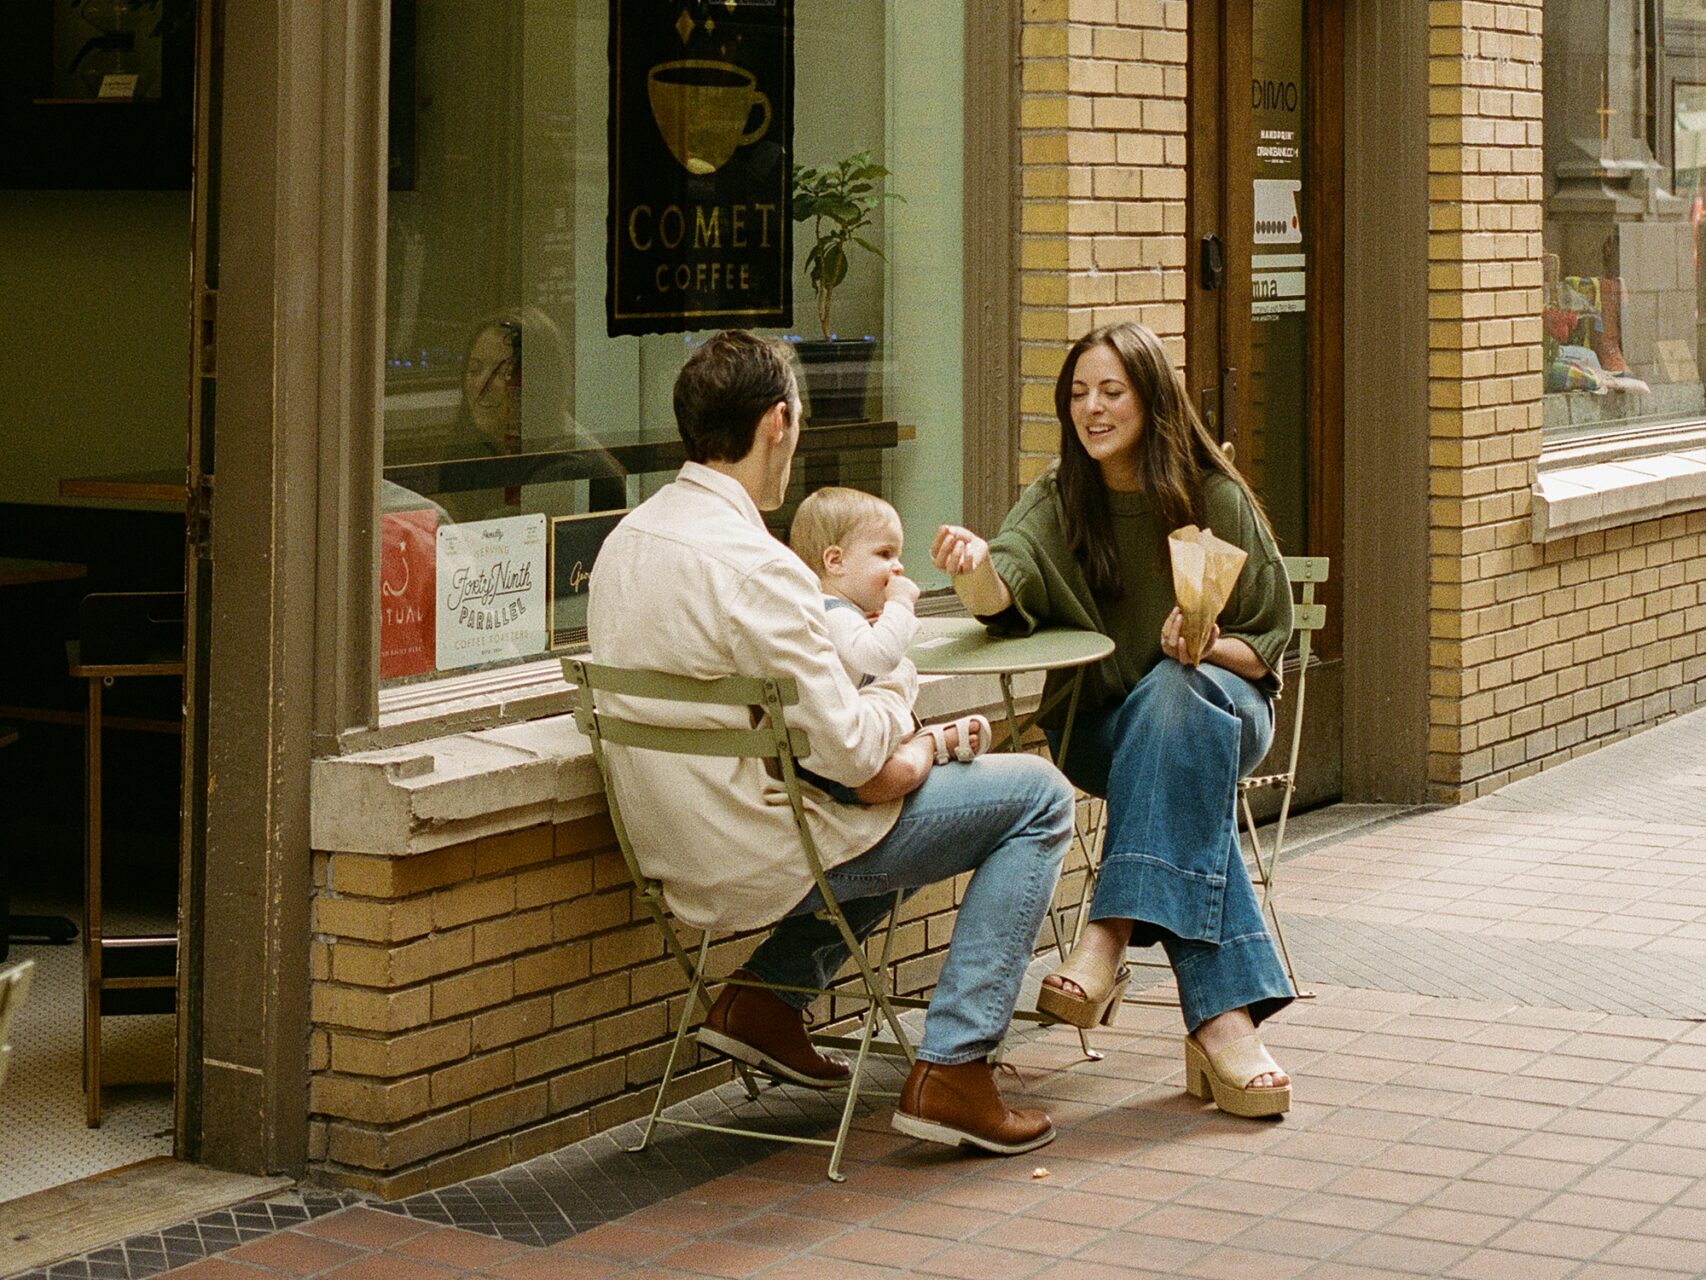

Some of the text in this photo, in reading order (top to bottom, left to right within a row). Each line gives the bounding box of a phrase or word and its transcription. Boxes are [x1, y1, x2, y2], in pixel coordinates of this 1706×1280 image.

[1251, 79, 1298, 112] DIMO
[628, 203, 775, 251] COMET
[656, 263, 751, 292] COFFEE
[447, 560, 532, 611] Forty Ninth
[380, 606, 424, 627] TUAL
[458, 597, 527, 631] PARALLEL
[455, 636, 486, 651] COFFEE
